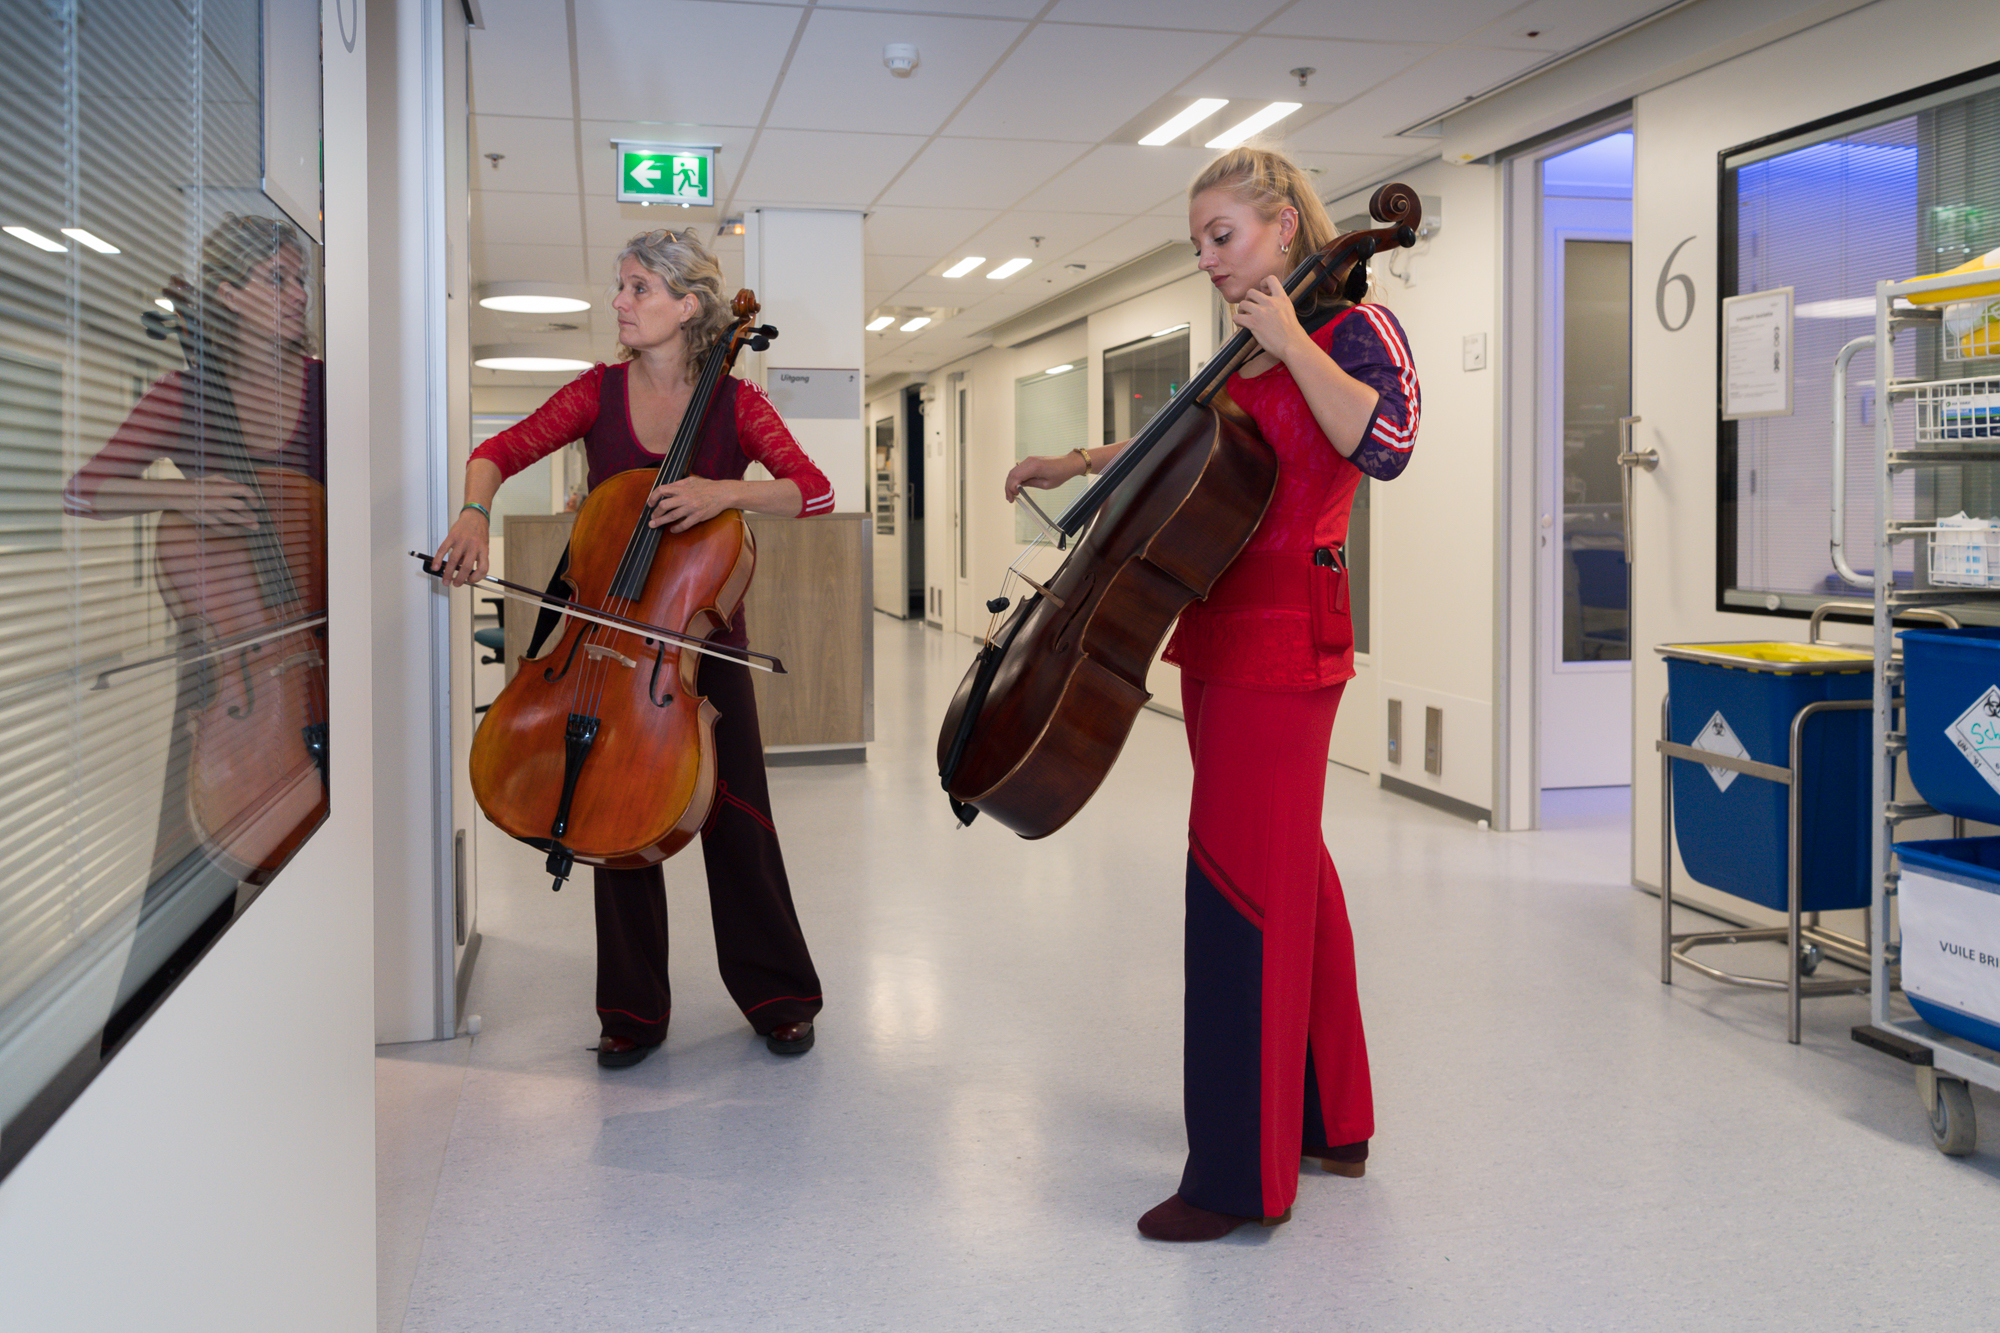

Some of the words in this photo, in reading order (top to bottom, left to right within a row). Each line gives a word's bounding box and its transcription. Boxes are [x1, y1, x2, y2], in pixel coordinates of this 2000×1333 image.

[1655, 235, 1697, 332] 6
[780, 374, 809, 383] Uitgang
[1939, 940, 1975, 961] VUILE
[1979, 952, 1999, 968] BRI
